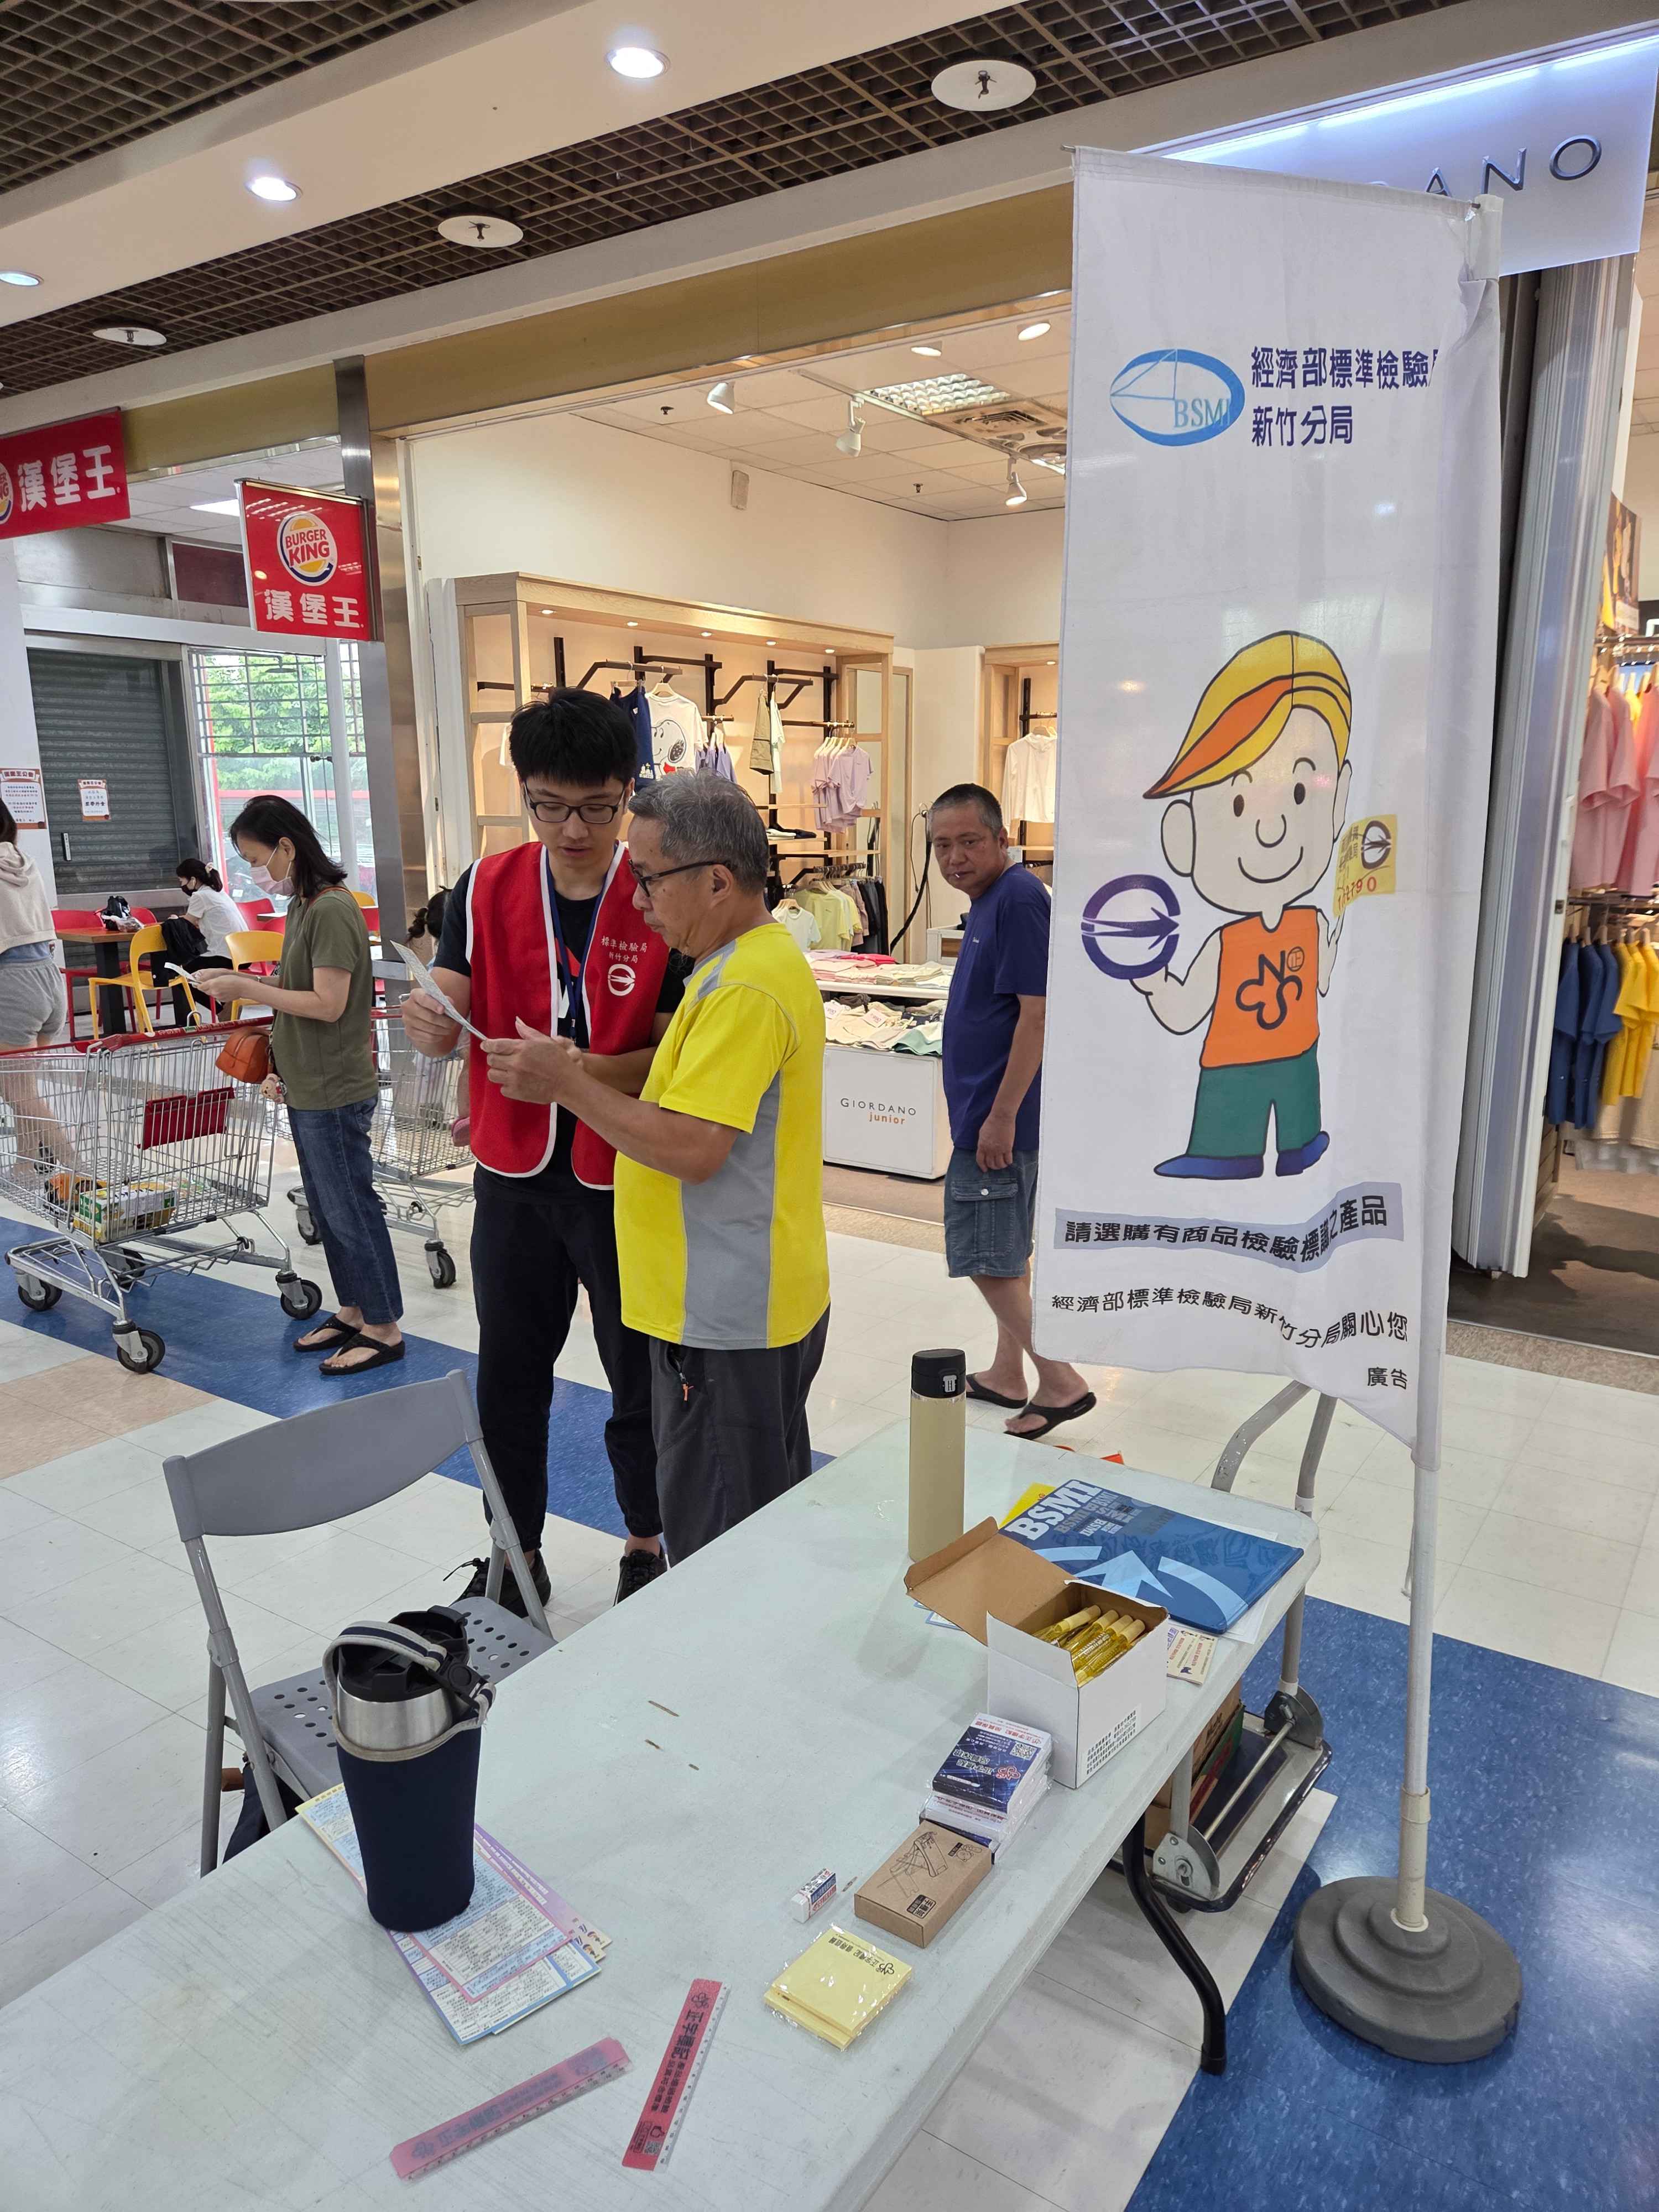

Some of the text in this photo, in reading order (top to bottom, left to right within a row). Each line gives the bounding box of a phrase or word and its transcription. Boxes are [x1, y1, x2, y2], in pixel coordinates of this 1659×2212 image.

[1368, 134, 1601, 197] ANO
[1251, 346, 1438, 389] 經濟部標準檢驗
[1174, 398, 1230, 427] BSMI
[1251, 405, 1353, 446] 新竹分局
[18, 445, 116, 512] 漢堡王
[285, 529, 327, 549] BURGER
[288, 541, 330, 567] KING
[264, 589, 360, 628] 漢堡王
[601, 935, 648, 952] 標準檢驗局
[608, 951, 638, 963] 新竹分局
[841, 1098, 916, 1115] GIORDANO
[869, 1112, 905, 1124] junior
[1051, 1287, 1408, 1349] 經濟部標準檢驗局新竹分局關心您
[1367, 1367, 1408, 1389] 廣告
[1004, 1480, 1103, 1541] BSMI
